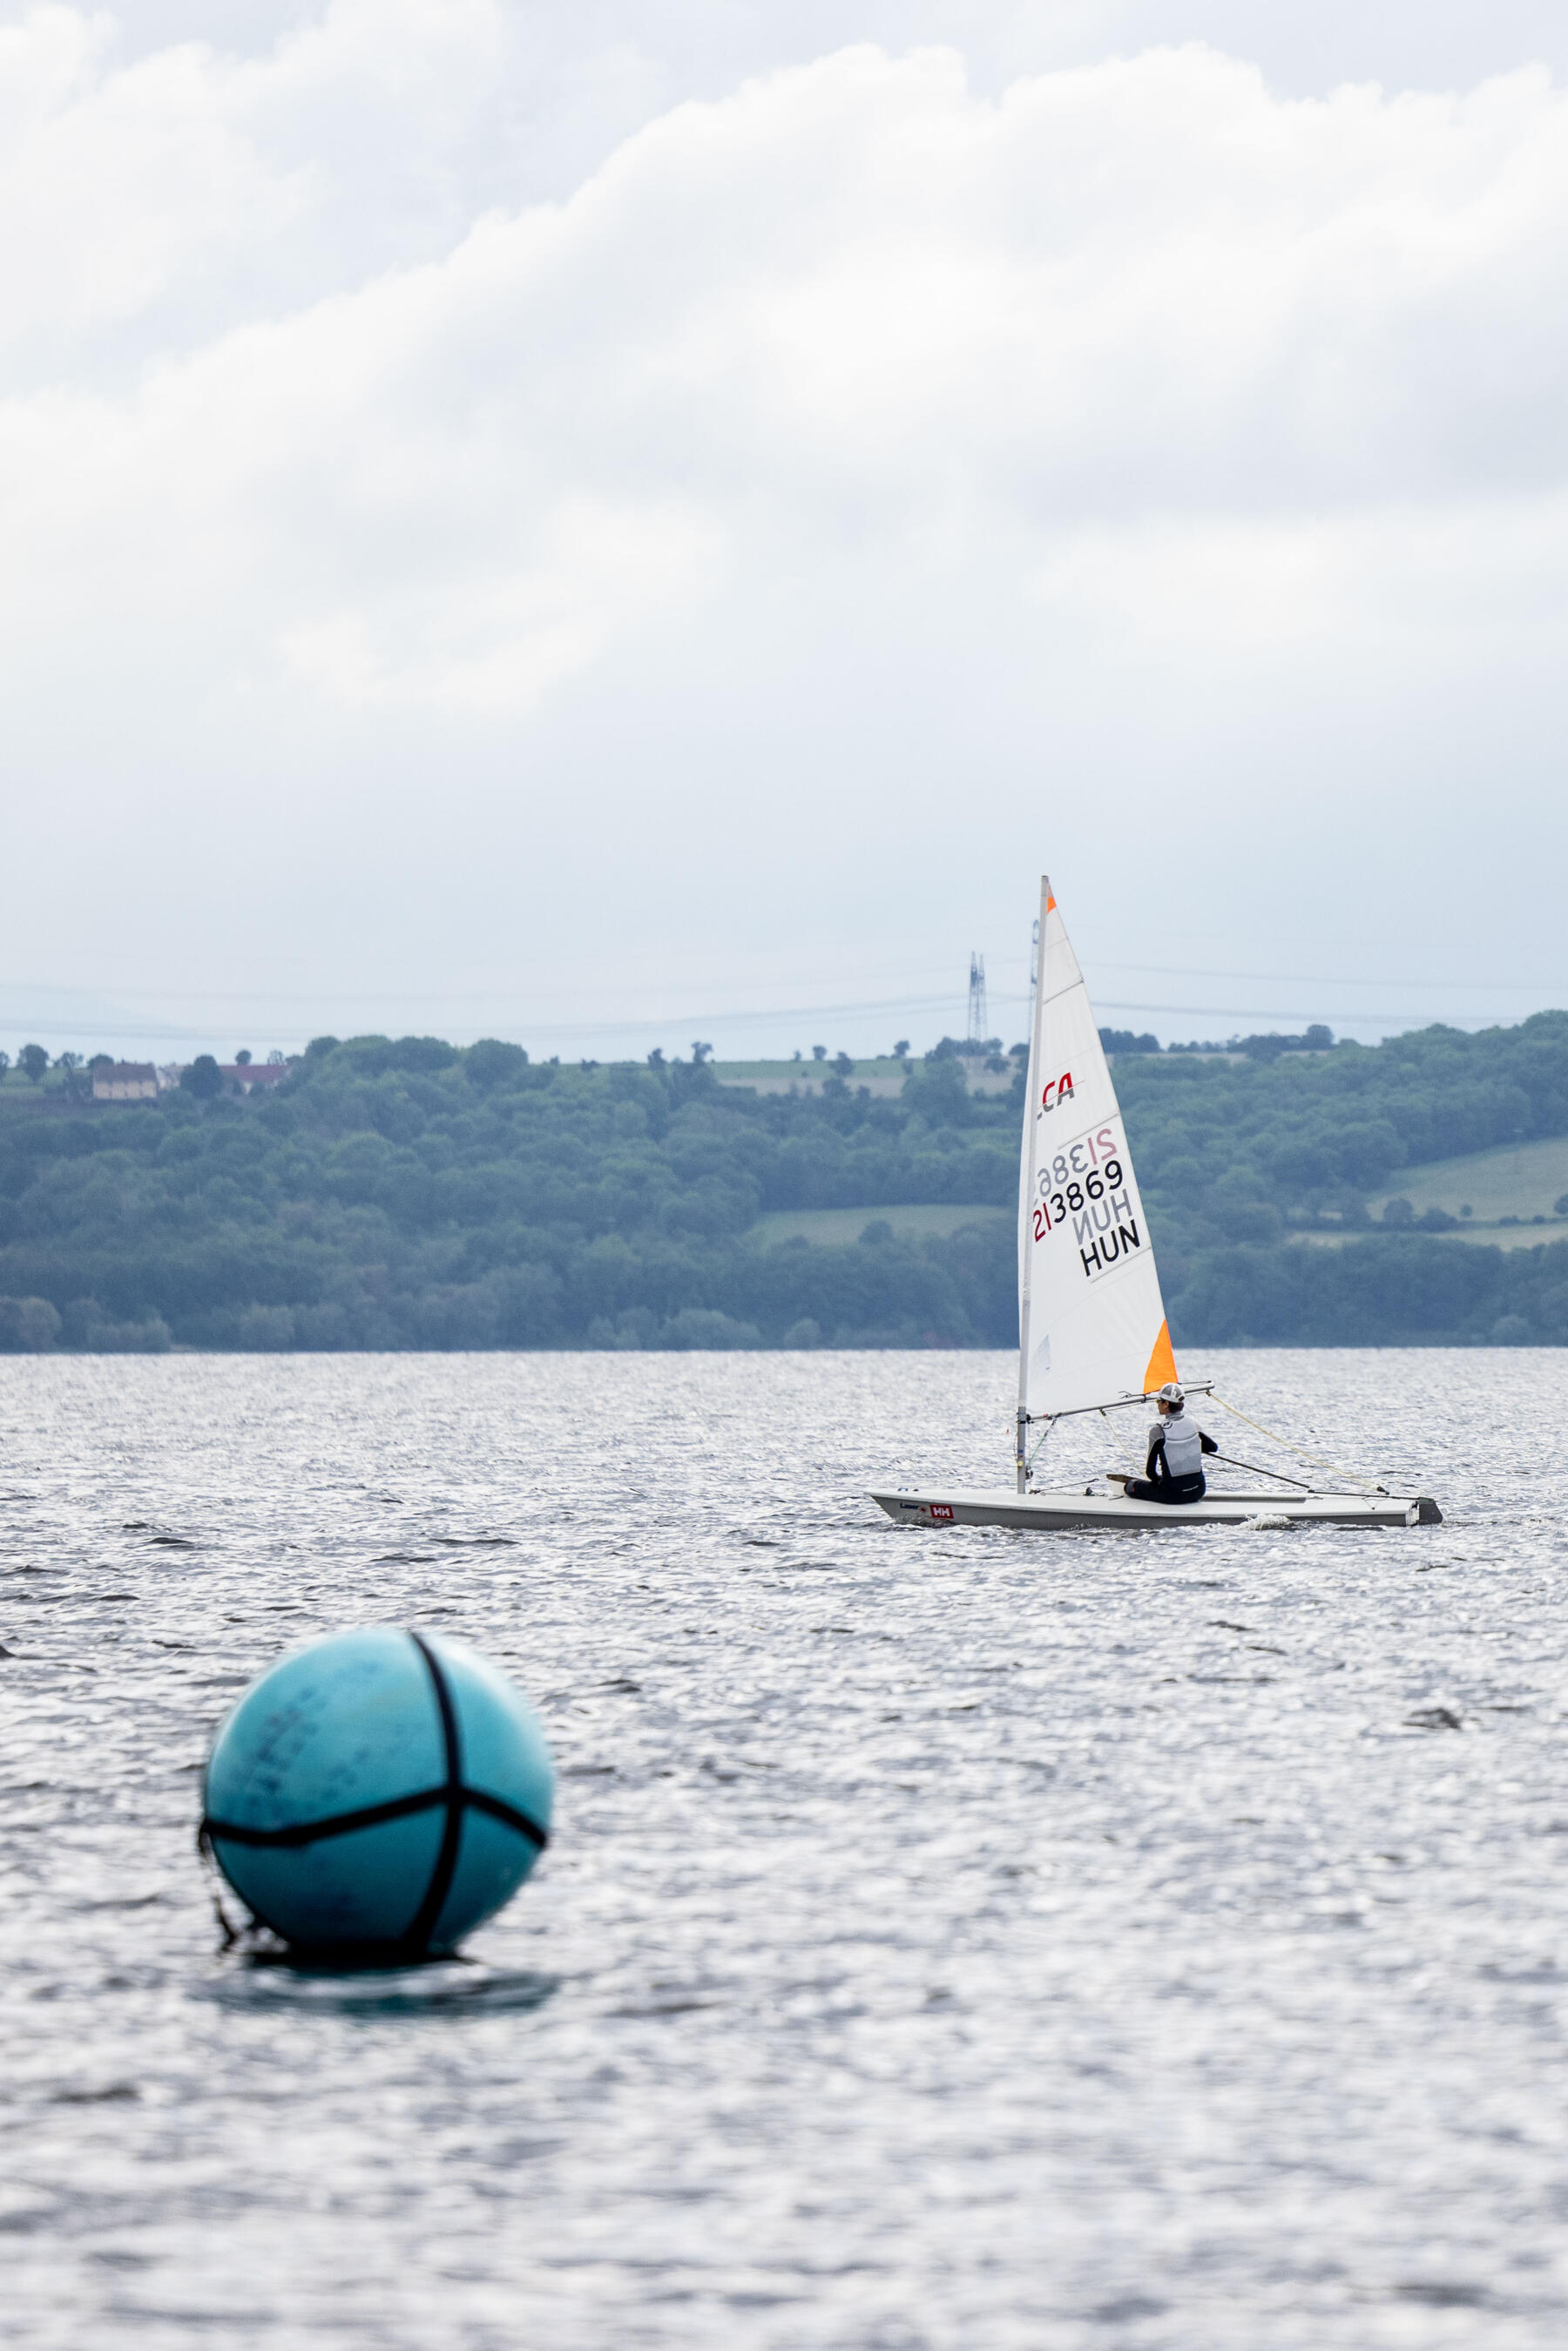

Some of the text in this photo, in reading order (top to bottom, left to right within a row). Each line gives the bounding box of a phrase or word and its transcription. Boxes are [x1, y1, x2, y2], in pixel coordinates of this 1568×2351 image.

[1037, 1073, 1074, 1121] CA
[1033, 1161, 1123, 1243] 213869
[1080, 1219, 1140, 1277] HUN
[933, 1507, 950, 1516] HH
